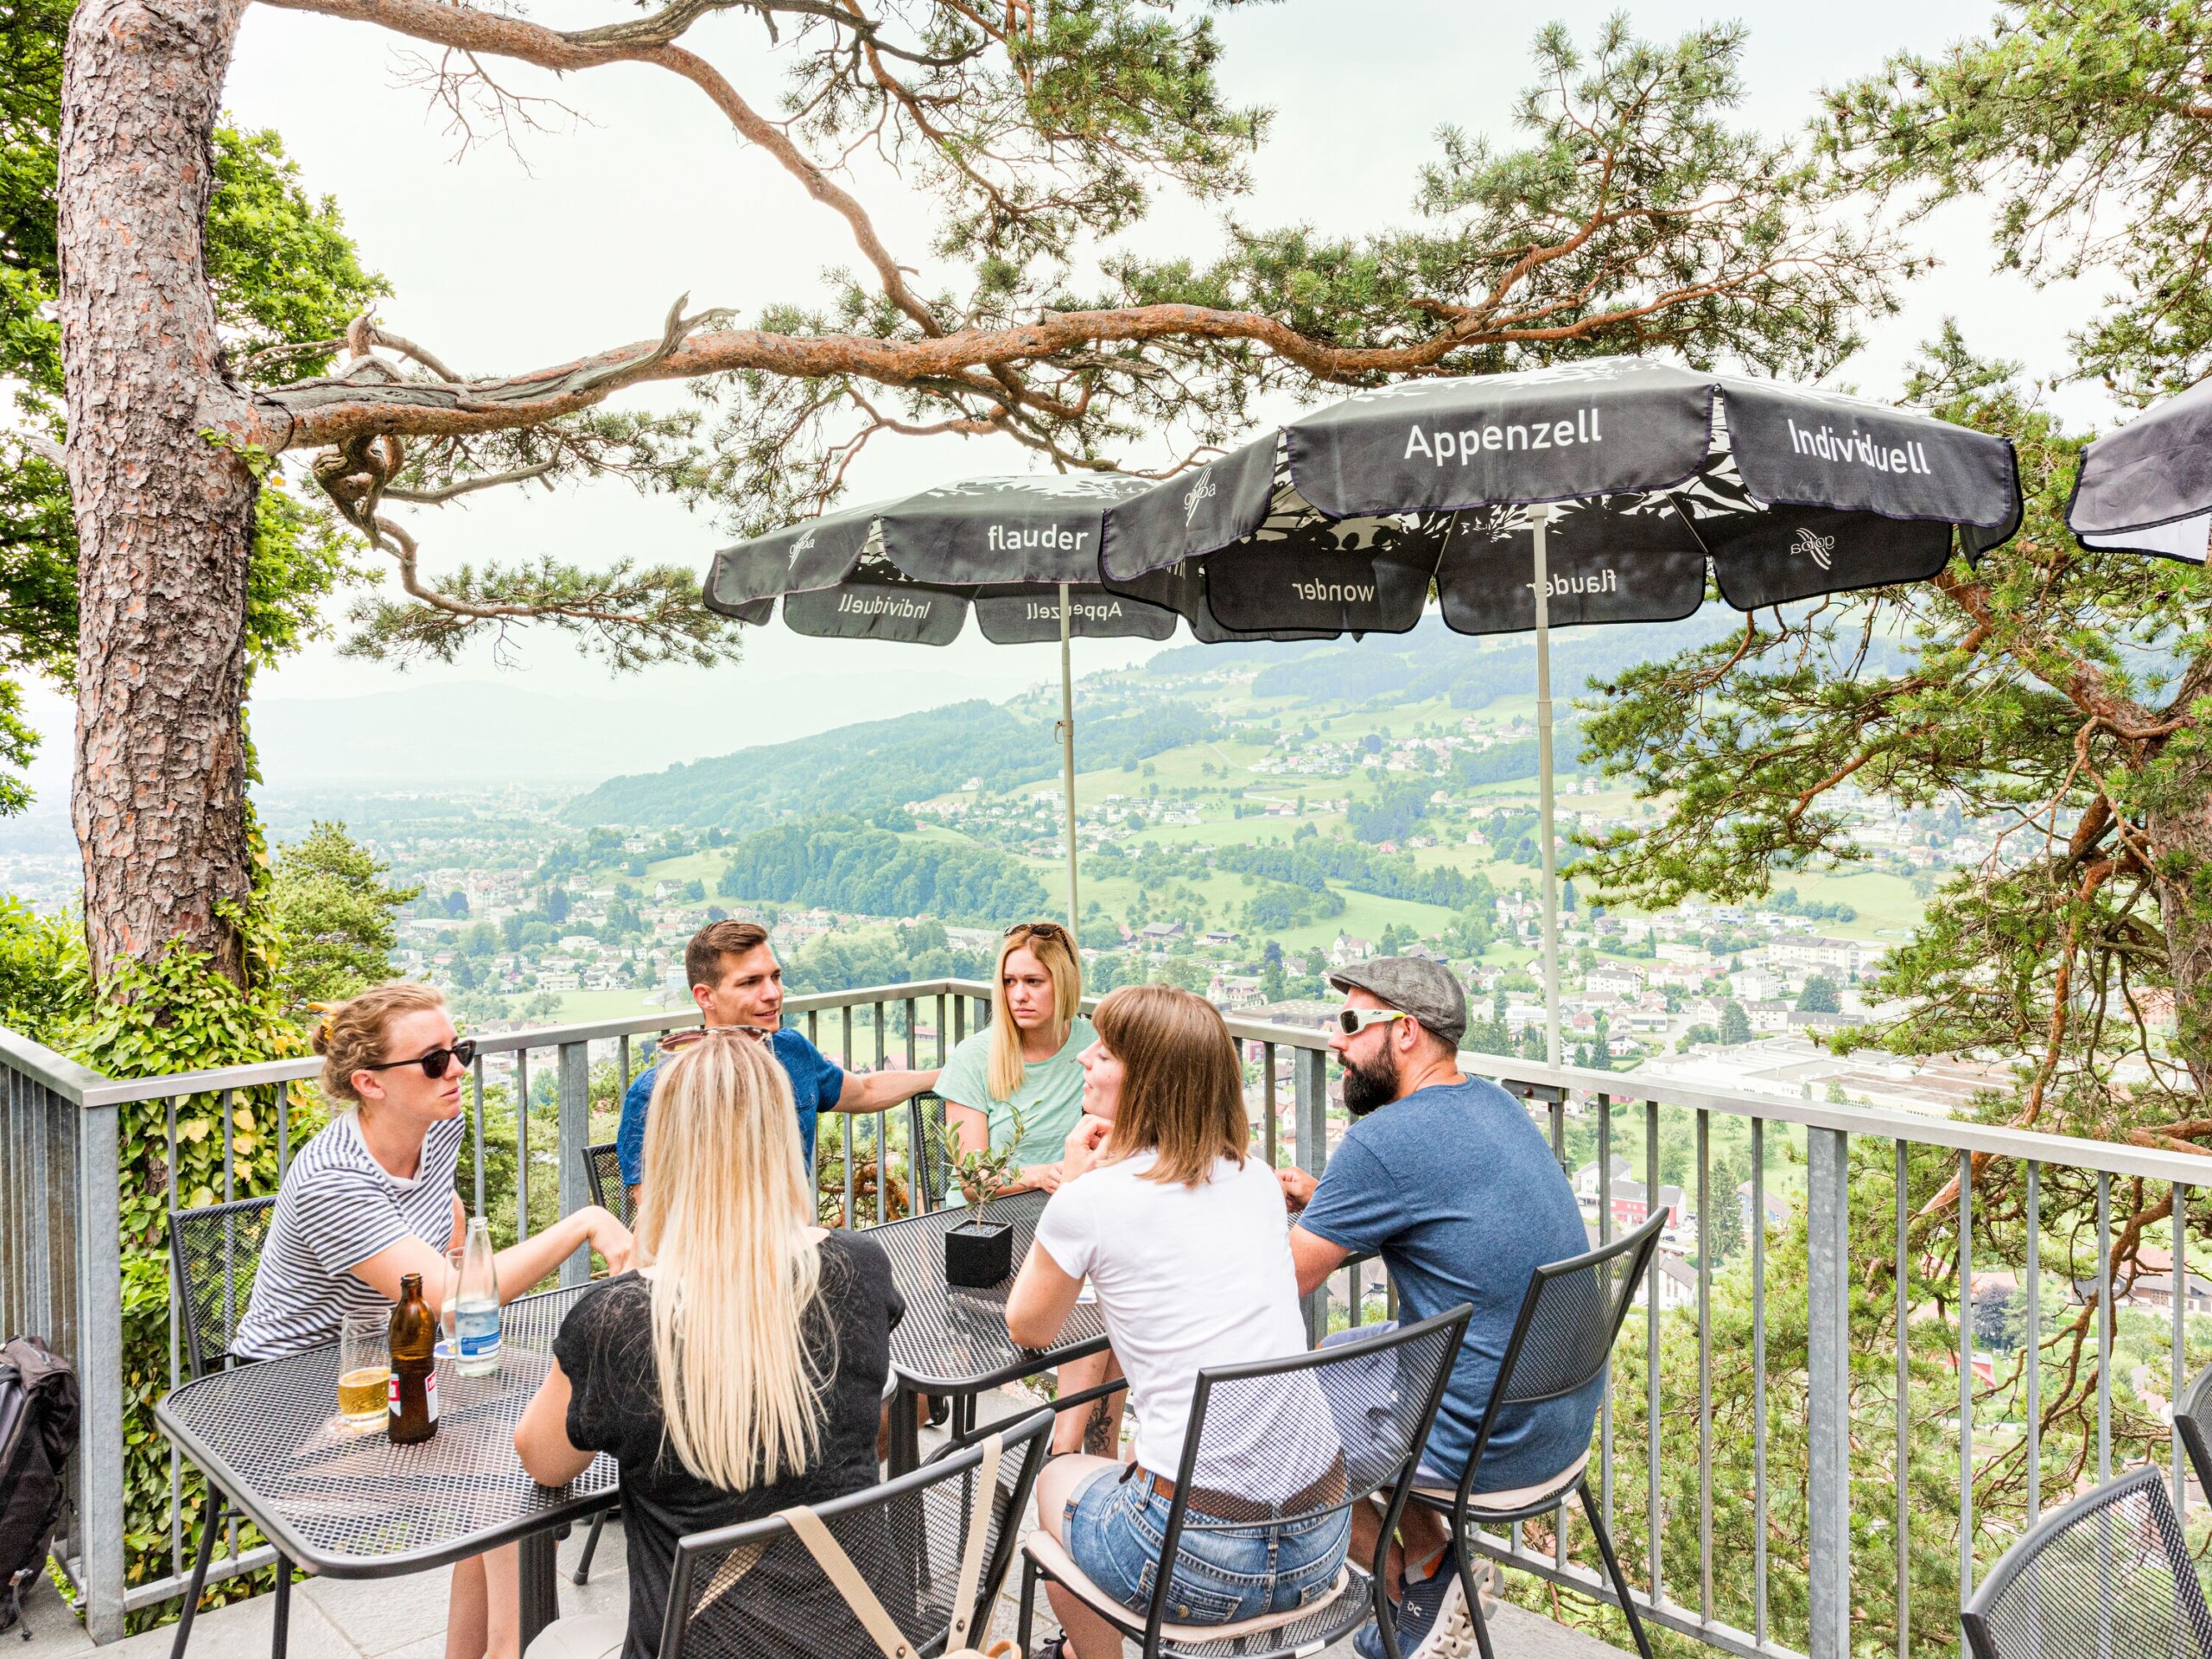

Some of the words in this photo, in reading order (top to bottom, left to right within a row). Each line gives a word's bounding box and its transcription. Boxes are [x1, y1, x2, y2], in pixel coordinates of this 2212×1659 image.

[1403, 408, 1602, 467] Appenzell
[1787, 418, 1932, 475] Individuell
[987, 523, 1090, 551] flauder
